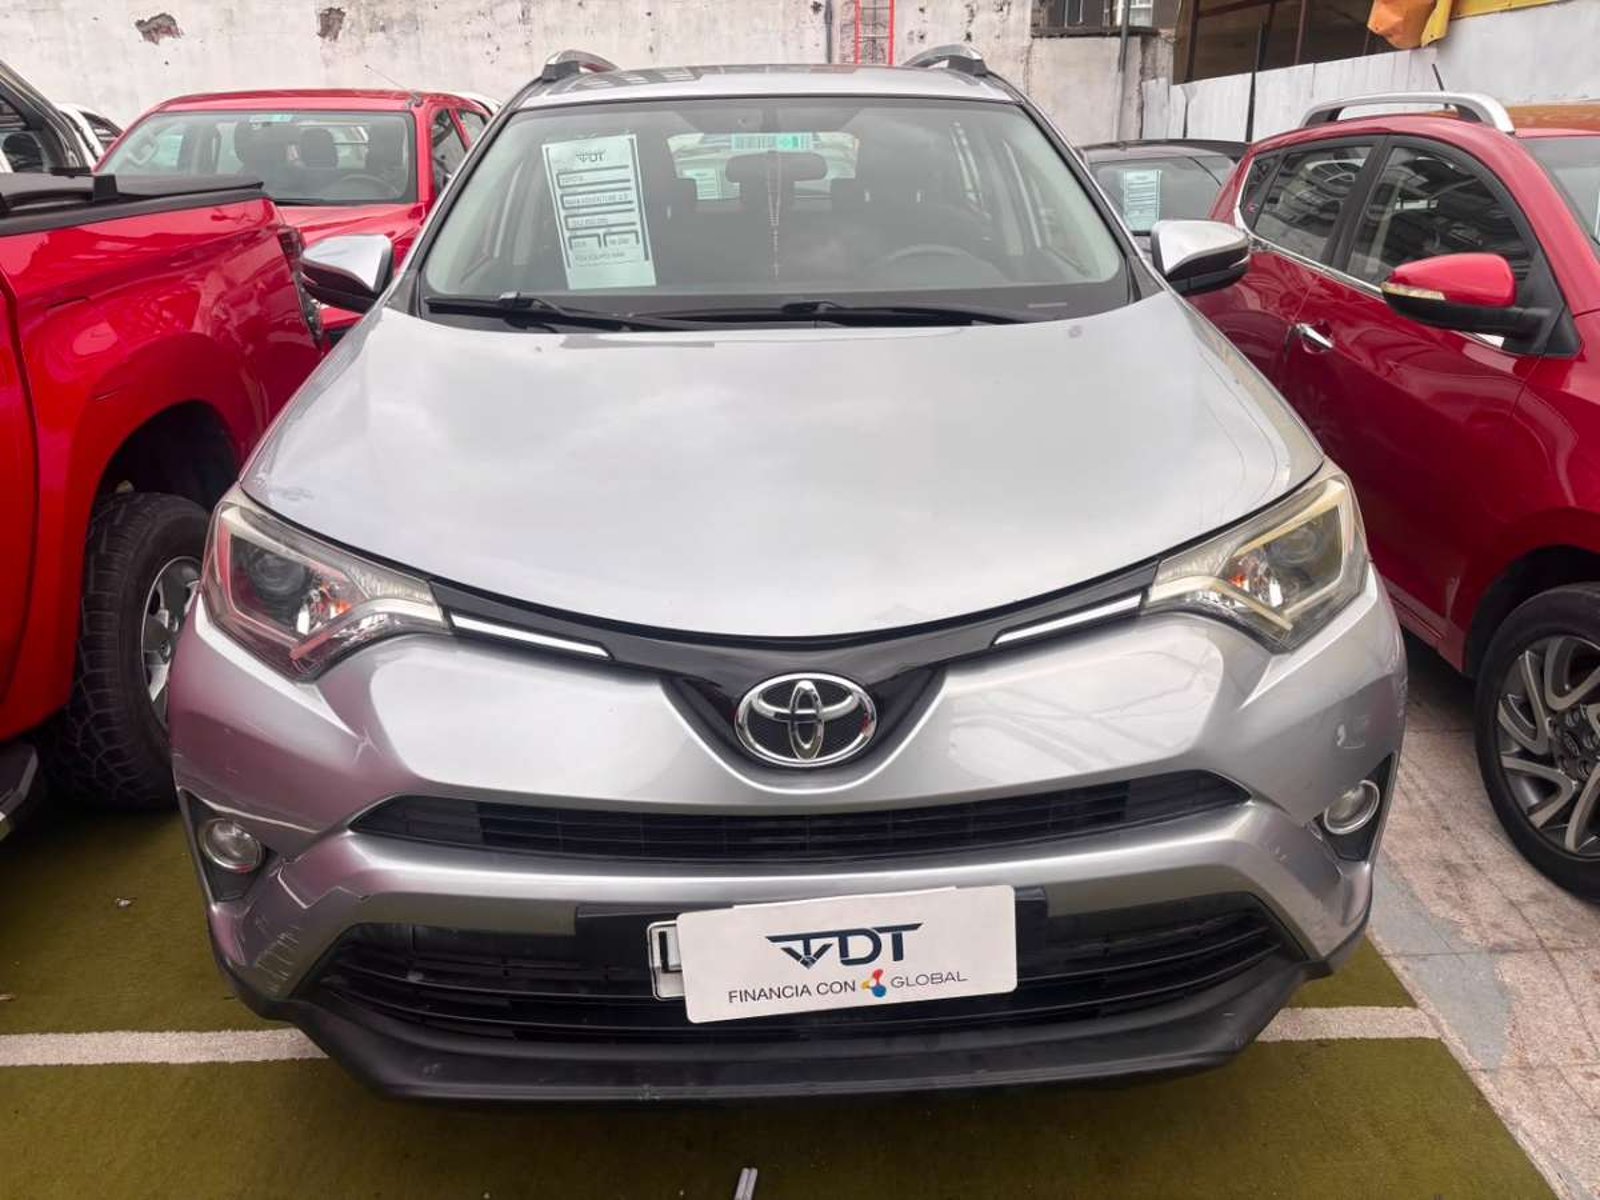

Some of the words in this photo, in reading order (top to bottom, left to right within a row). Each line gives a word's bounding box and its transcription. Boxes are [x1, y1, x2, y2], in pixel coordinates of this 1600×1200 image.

[728, 984, 812, 1003] FINANCIA
[816, 980, 857, 996] CON
[890, 971, 969, 989] GLOBAL
